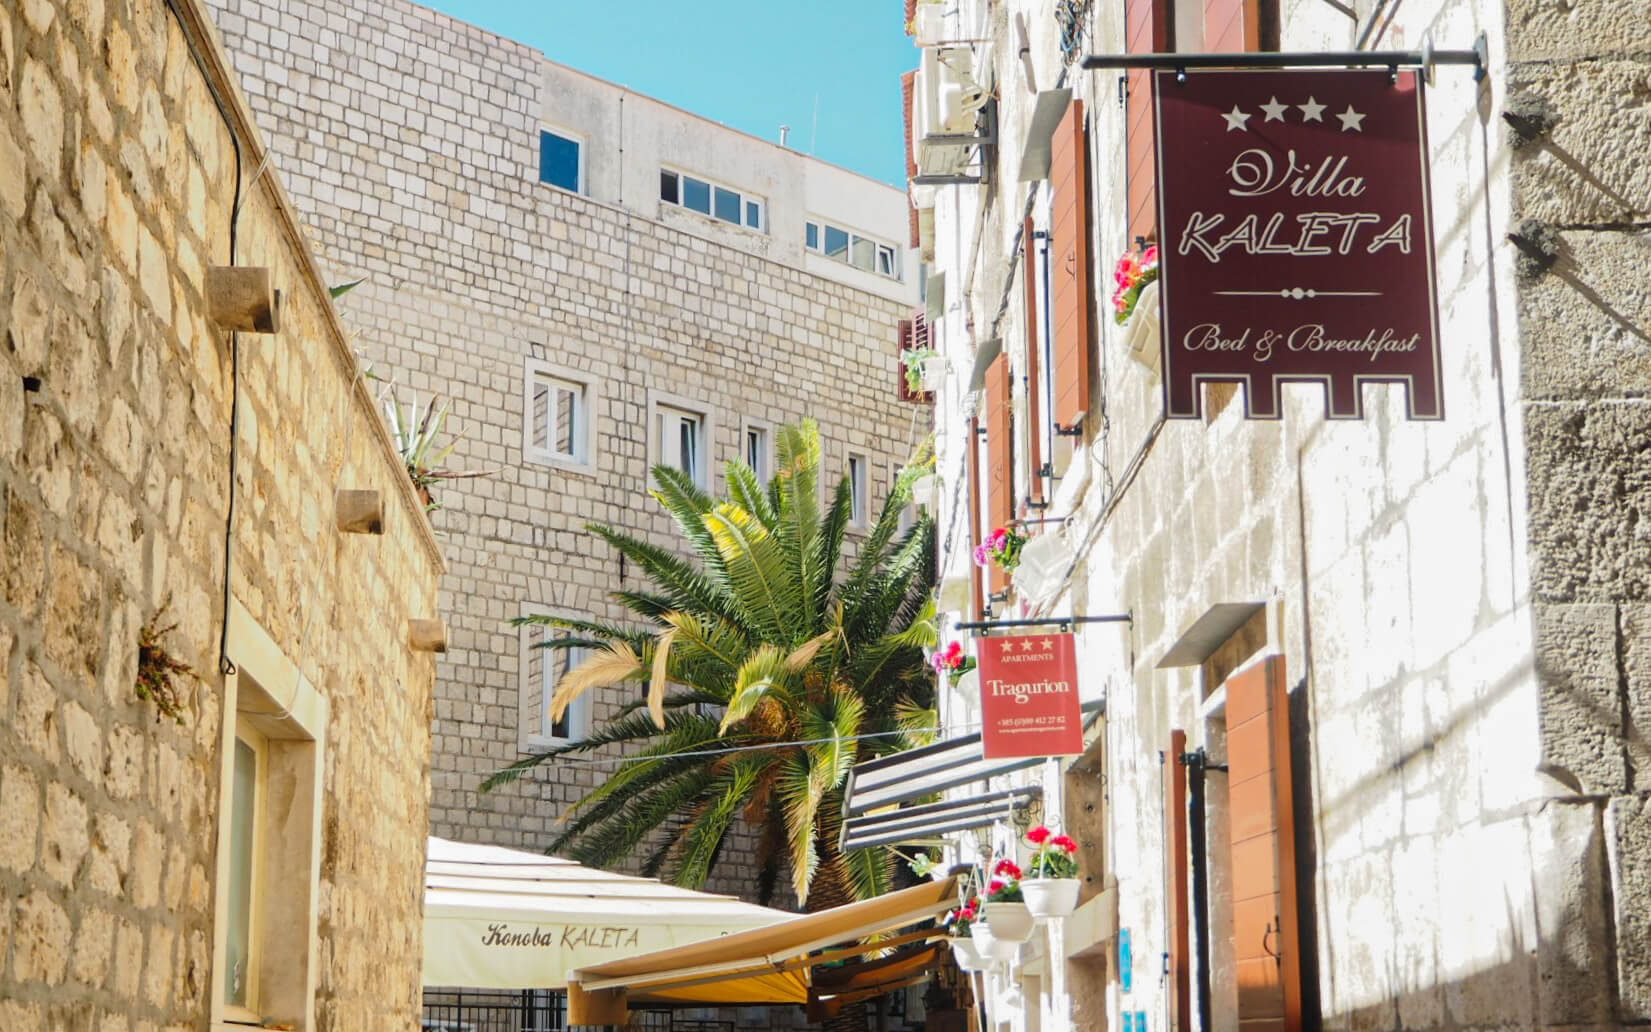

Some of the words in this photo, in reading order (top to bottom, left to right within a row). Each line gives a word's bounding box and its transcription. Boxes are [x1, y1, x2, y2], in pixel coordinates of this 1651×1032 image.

[1225, 149, 1366, 197] Villa
[1179, 211, 1412, 262] KALETA
[1183, 324, 1250, 351] Bed
[1253, 330, 1283, 362] &
[1287, 324, 1420, 362] Breakfast
[1000, 653, 1054, 663] APARTMENTS
[986, 679, 1070, 704] Tragurion
[481, 923, 552, 947] Konoba
[559, 924, 639, 950] KALETA
